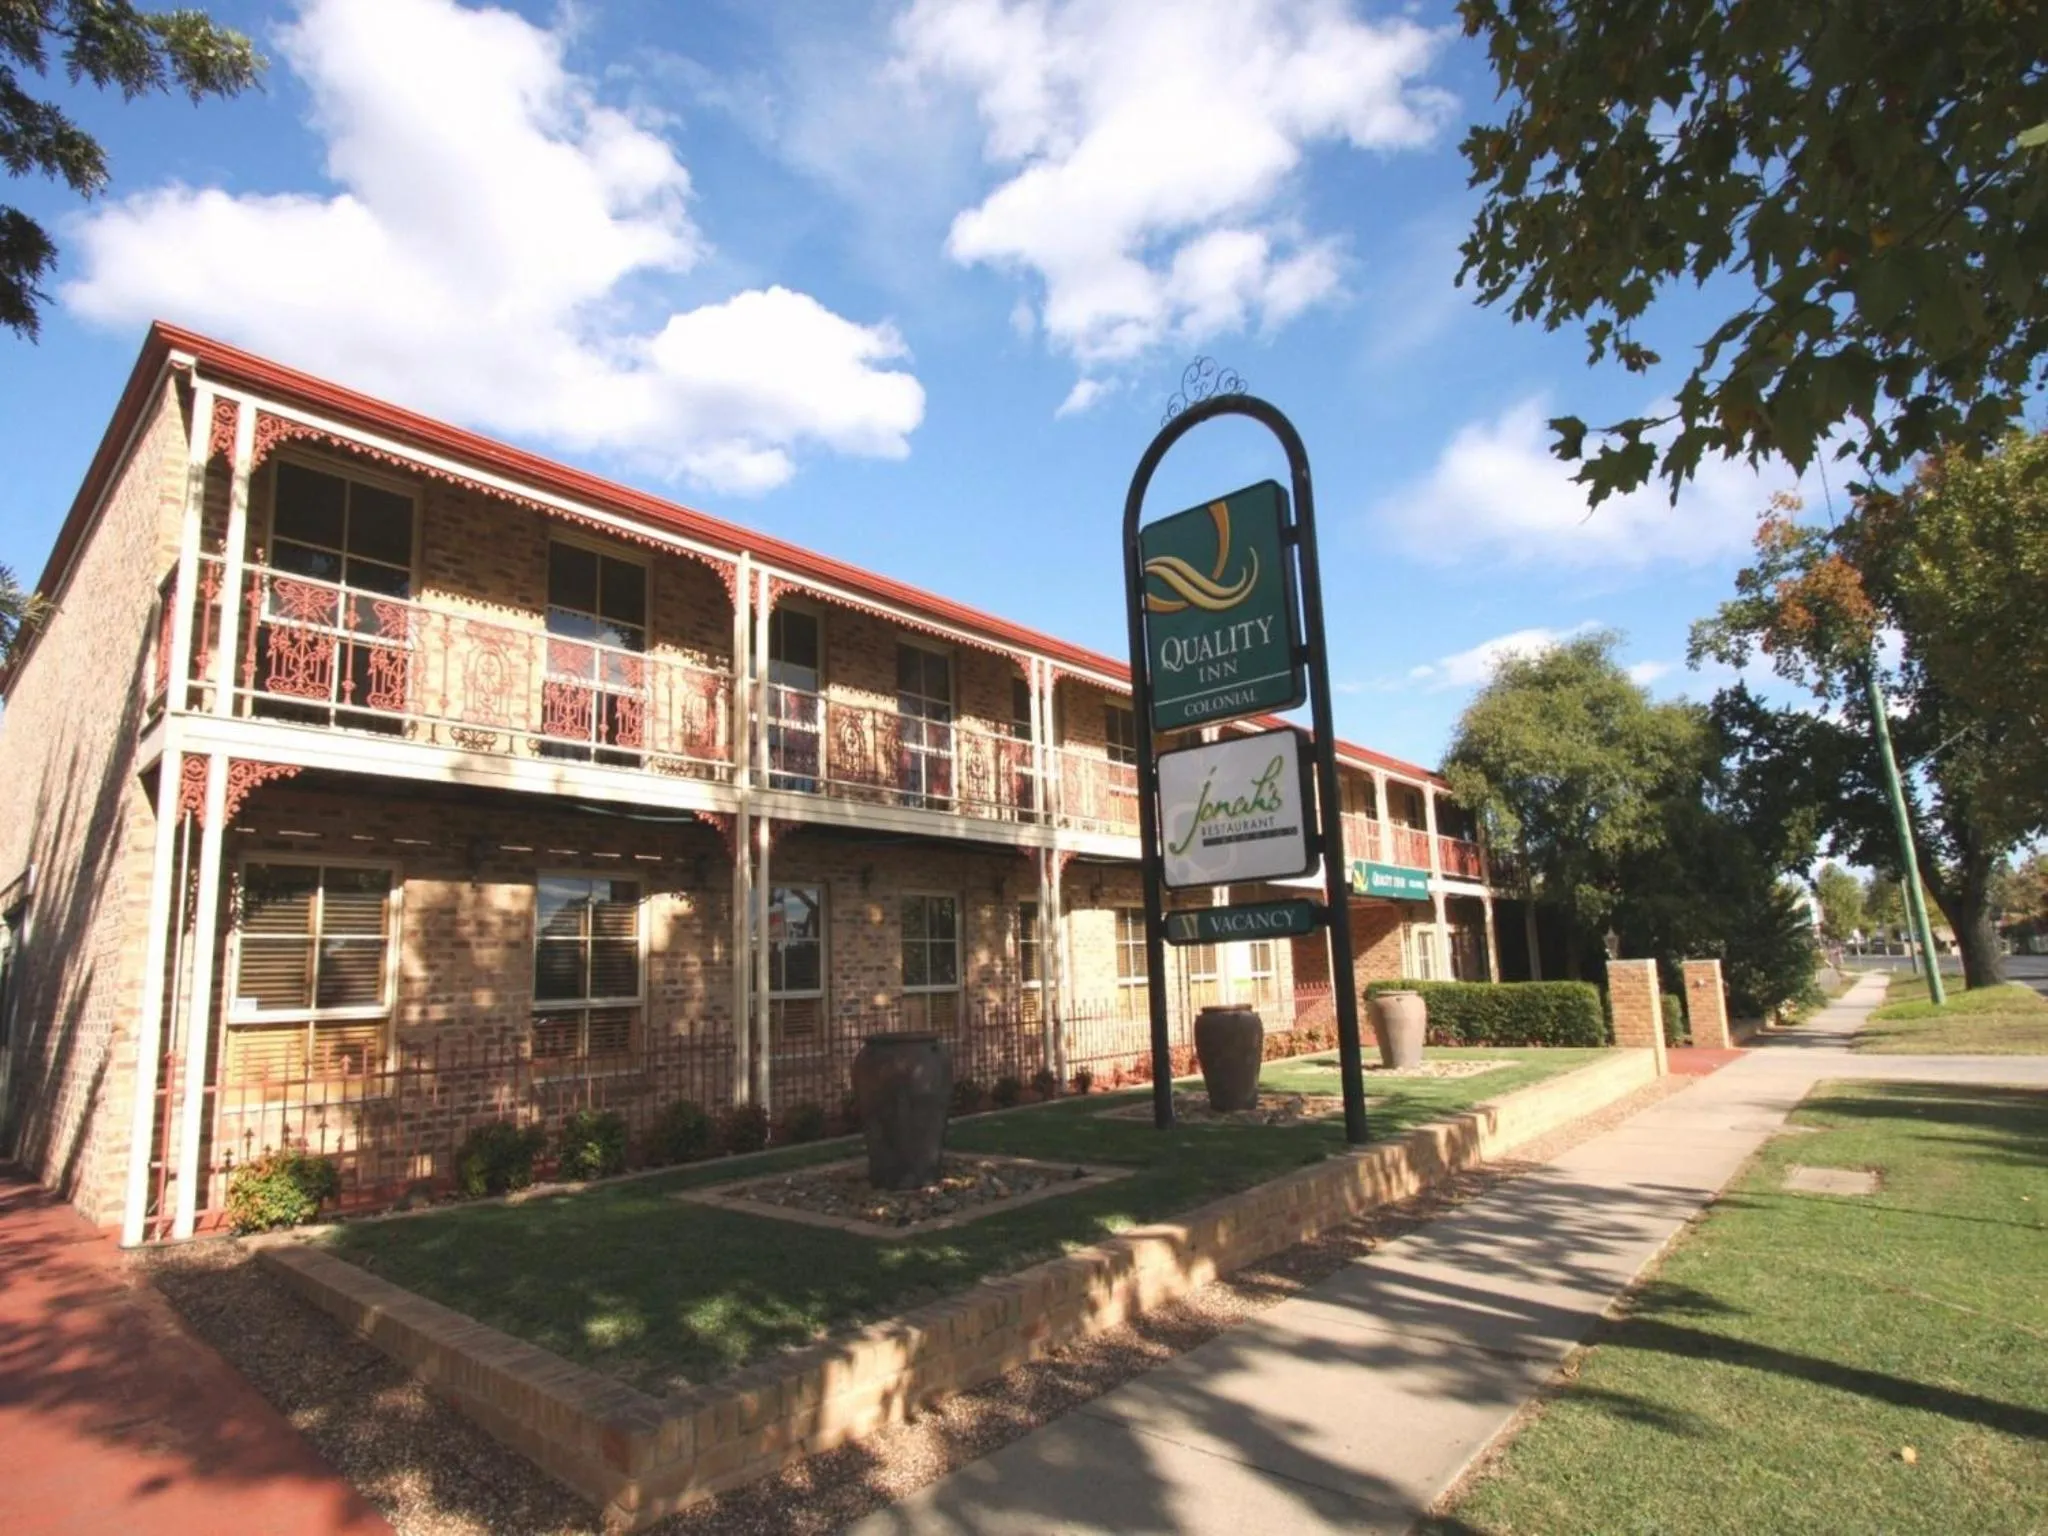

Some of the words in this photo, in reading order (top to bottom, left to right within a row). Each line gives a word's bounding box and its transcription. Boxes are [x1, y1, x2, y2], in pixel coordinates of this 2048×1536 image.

[1161, 614, 1274, 673] QUALITY
[1198, 659, 1238, 683] INN
[1184, 688, 1257, 717] COLONIAL
[1202, 815, 1276, 837] RESTAURANT
[1210, 908, 1295, 933] VACANCY
